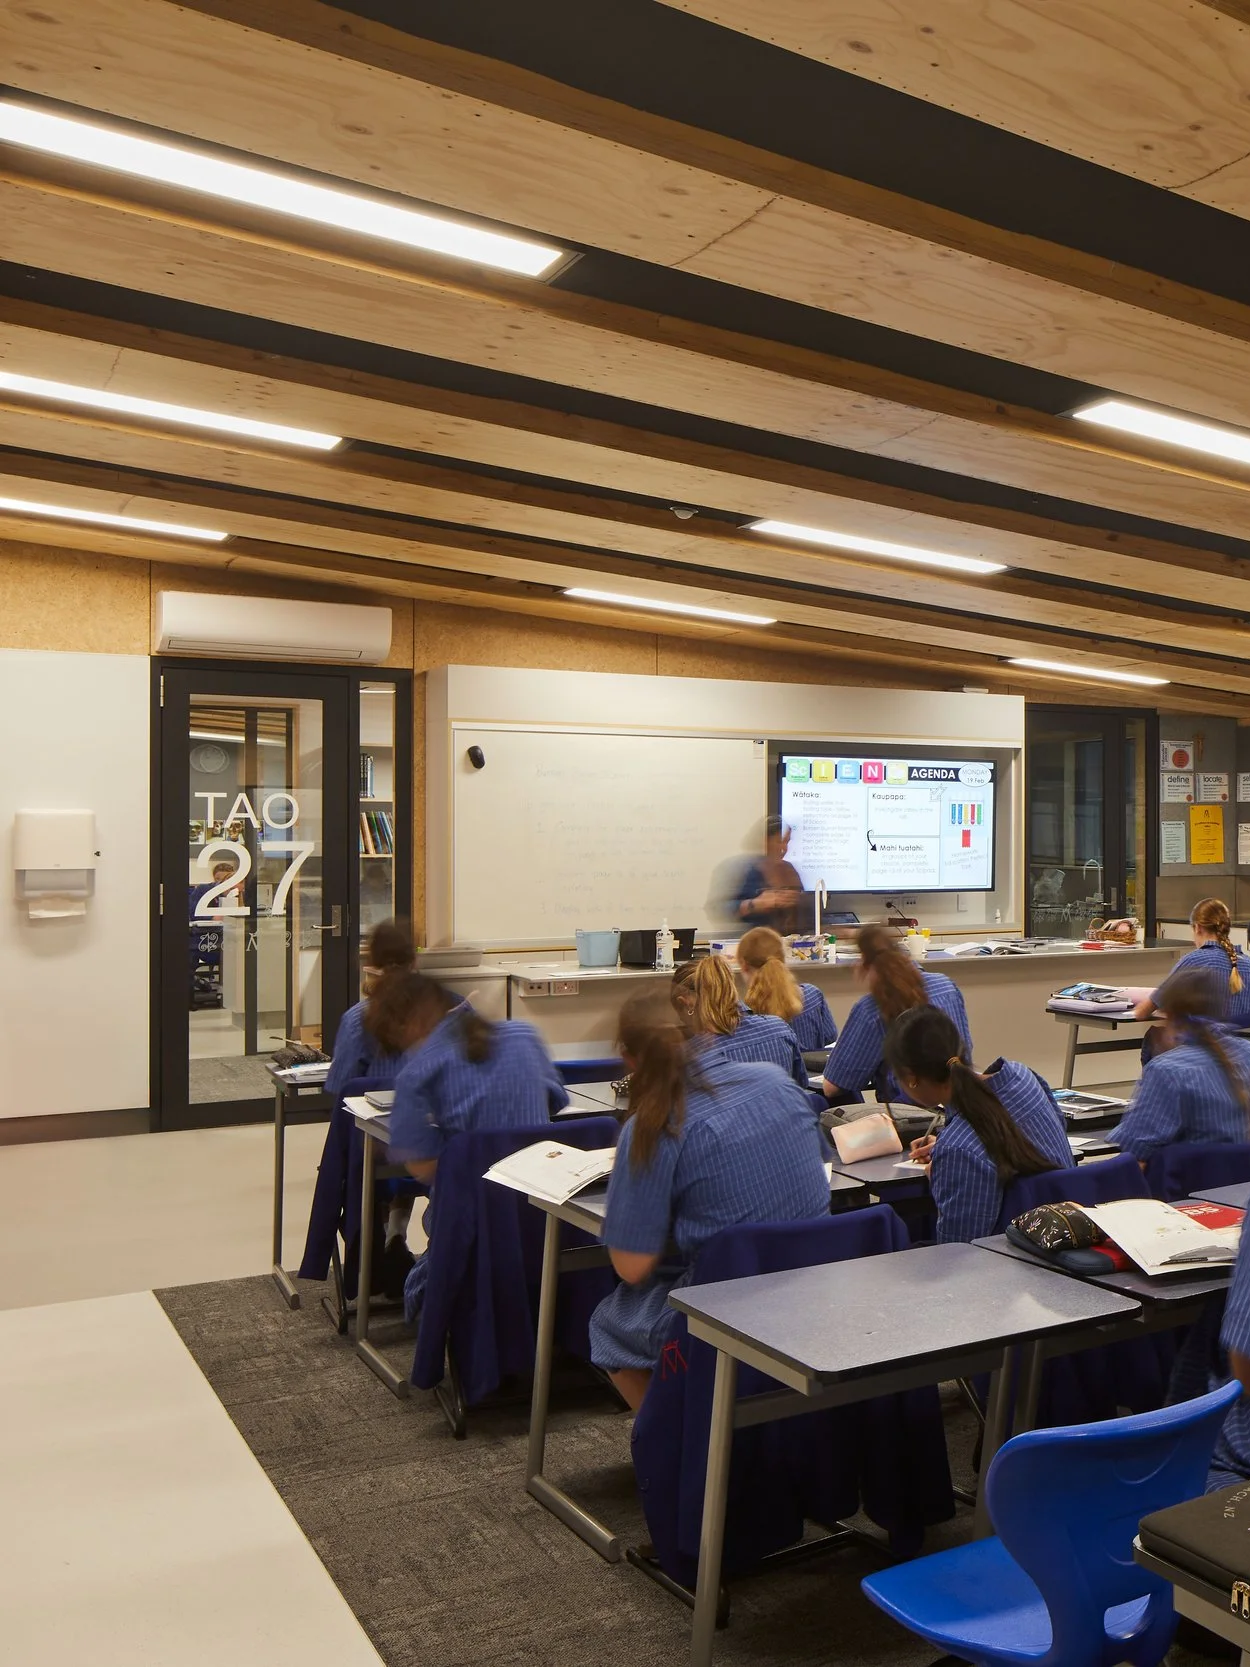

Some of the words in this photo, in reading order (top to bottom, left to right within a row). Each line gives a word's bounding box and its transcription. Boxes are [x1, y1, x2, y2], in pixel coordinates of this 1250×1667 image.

[868, 765, 878, 777] N
[911, 768, 956, 779] AGENDA
[194, 792, 299, 830] TAO
[194, 841, 316, 917] 27
[1223, 1506, 1235, 1518] NZ
